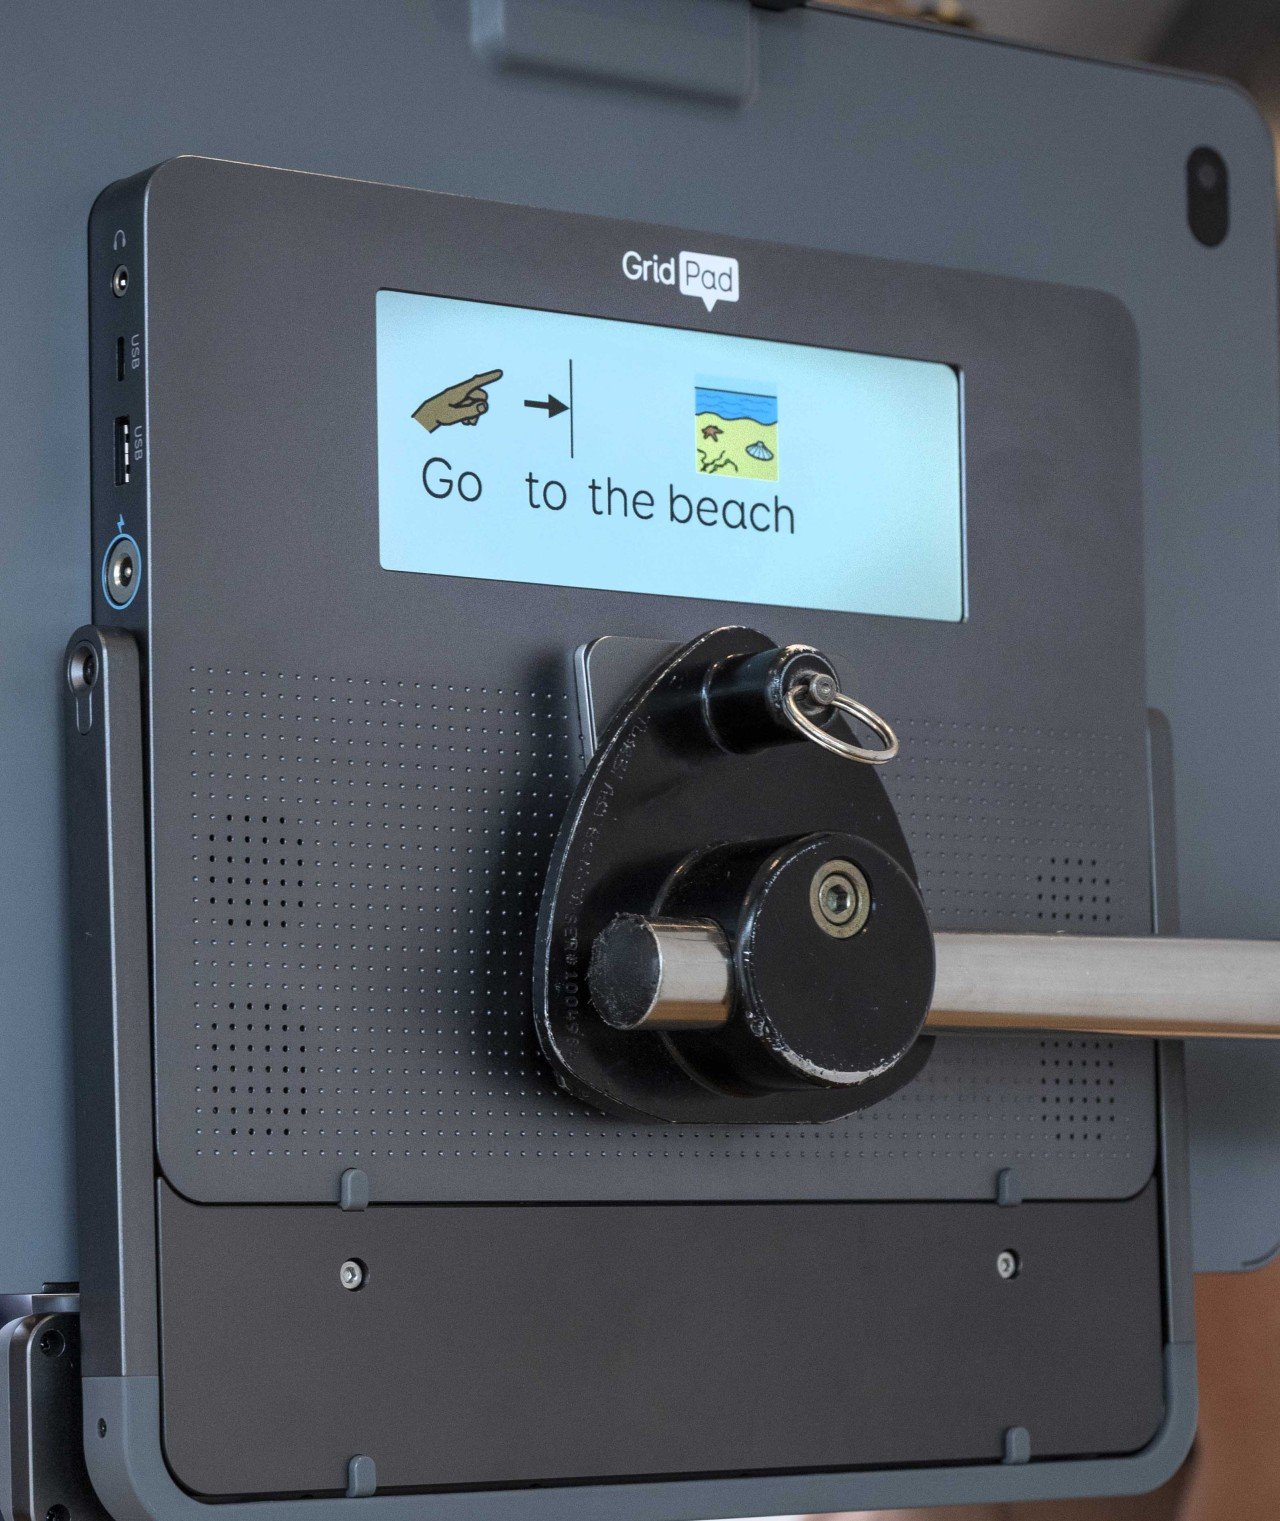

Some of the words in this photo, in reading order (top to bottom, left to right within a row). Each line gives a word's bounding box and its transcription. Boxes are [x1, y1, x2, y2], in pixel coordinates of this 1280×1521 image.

[622, 250, 676, 286] Grid
[685, 260, 733, 292] Pad
[131, 334, 141, 370] USB
[133, 426, 143, 461] USB
[422, 457, 483, 502] Go
[525, 471, 567, 511] to
[588, 476, 655, 520] the
[670, 483, 795, 535] beach
